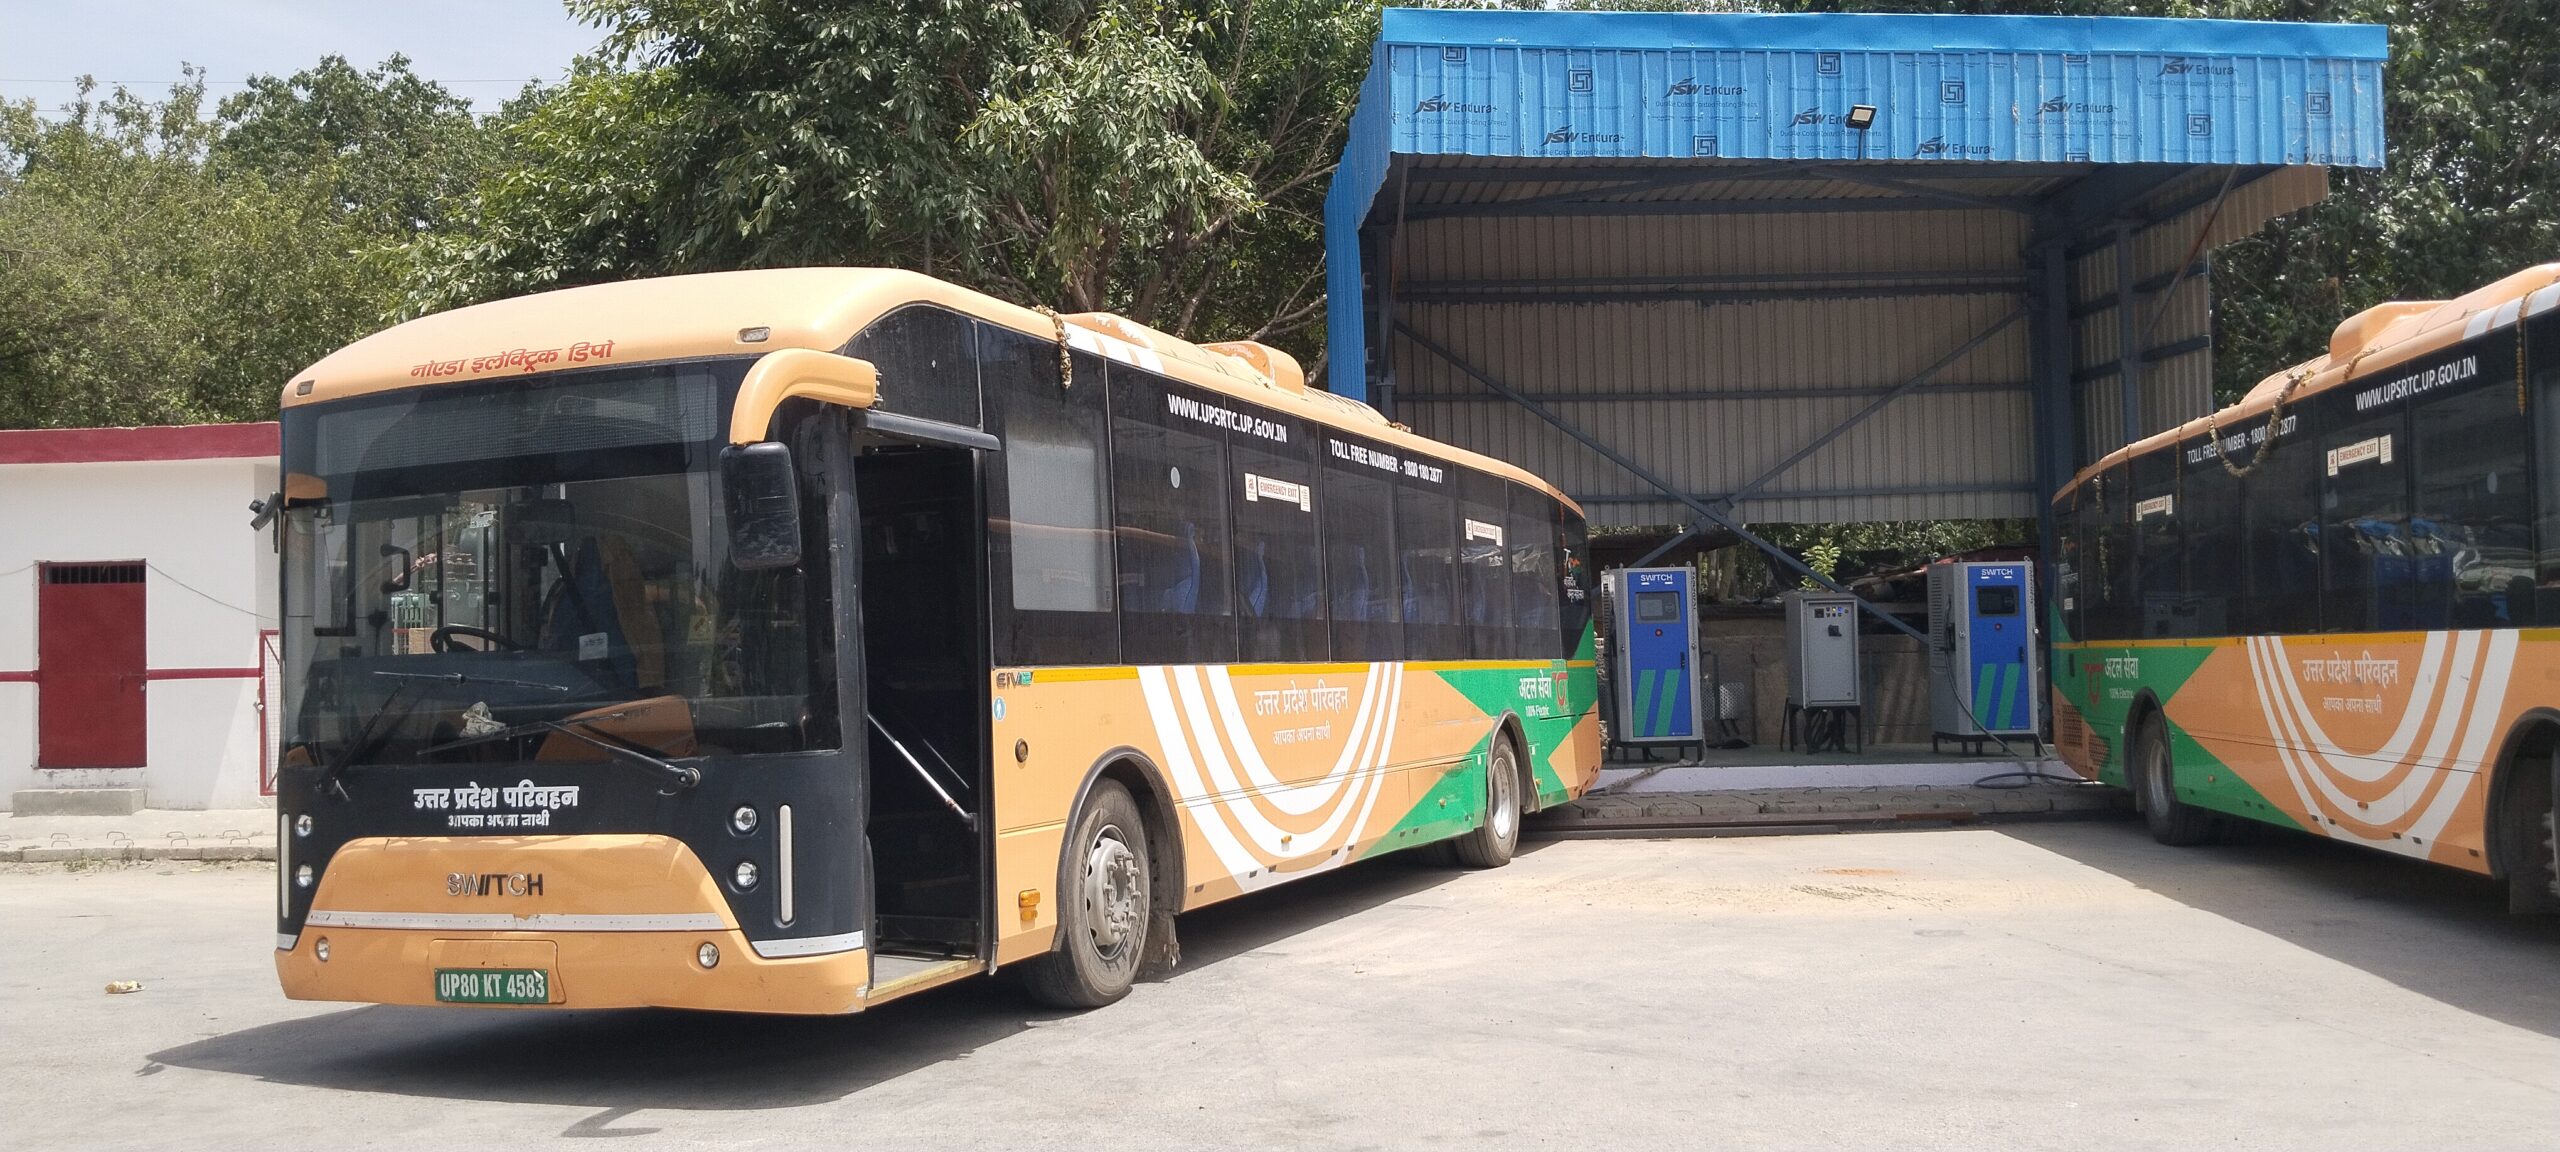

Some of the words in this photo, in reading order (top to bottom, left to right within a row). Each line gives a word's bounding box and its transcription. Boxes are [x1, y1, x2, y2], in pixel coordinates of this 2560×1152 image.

[2157, 62, 2194, 77] JSW
[1663, 83, 1702, 98] JSW
[1413, 100, 1450, 115] JSW
[1787, 113, 1827, 128] JSW
[1540, 131, 1579, 146] JSW
[1912, 143, 1950, 157] JSW
[410, 359, 468, 378] नोएडा
[567, 339, 615, 362] डिपो
[2355, 355, 2477, 411] WWW.UPSRTC.UP.GOV.IN
[1167, 393, 1287, 443] WWW.UPSRTC.UP.GOV.IN
[2187, 447, 2202, 464] TOLL
[2203, 442, 2217, 460] FREE
[2251, 425, 2266, 444] 1800
[2280, 414, 2297, 435] 2877
[1329, 438, 1350, 460] TOLL
[1351, 444, 1368, 465] FREE
[1368, 449, 1398, 473] NUMBER
[1403, 460, 1418, 478] 1800
[1429, 466, 1442, 484] 2877
[2339, 446, 2366, 462] EMERGENCY
[2367, 442, 2377, 454] EXIT
[1260, 481, 1287, 497] EMERGENCY
[1288, 487, 1297, 499] EXIT
[1640, 573, 1673, 582] SWITCH
[1981, 568, 2013, 576] SWITCH
[2302, 659, 2325, 682] उत्तर
[2326, 650, 2352, 685] प्रदेश
[2353, 650, 2399, 689] परिवहन
[1254, 690, 1280, 716] उत्तर
[1282, 680, 1308, 715] प्रदेश
[1310, 678, 1349, 715] परिवहन
[413, 788, 450, 809] उत्तर
[454, 781, 499, 810] प्रदेश
[503, 779, 579, 810] परिवहन
[448, 814, 485, 827] आपका
[447, 872, 544, 896] SWITCH
[440, 973, 479, 997] UP80
[483, 973, 502, 997] KT
[506, 974, 545, 998] 4583
